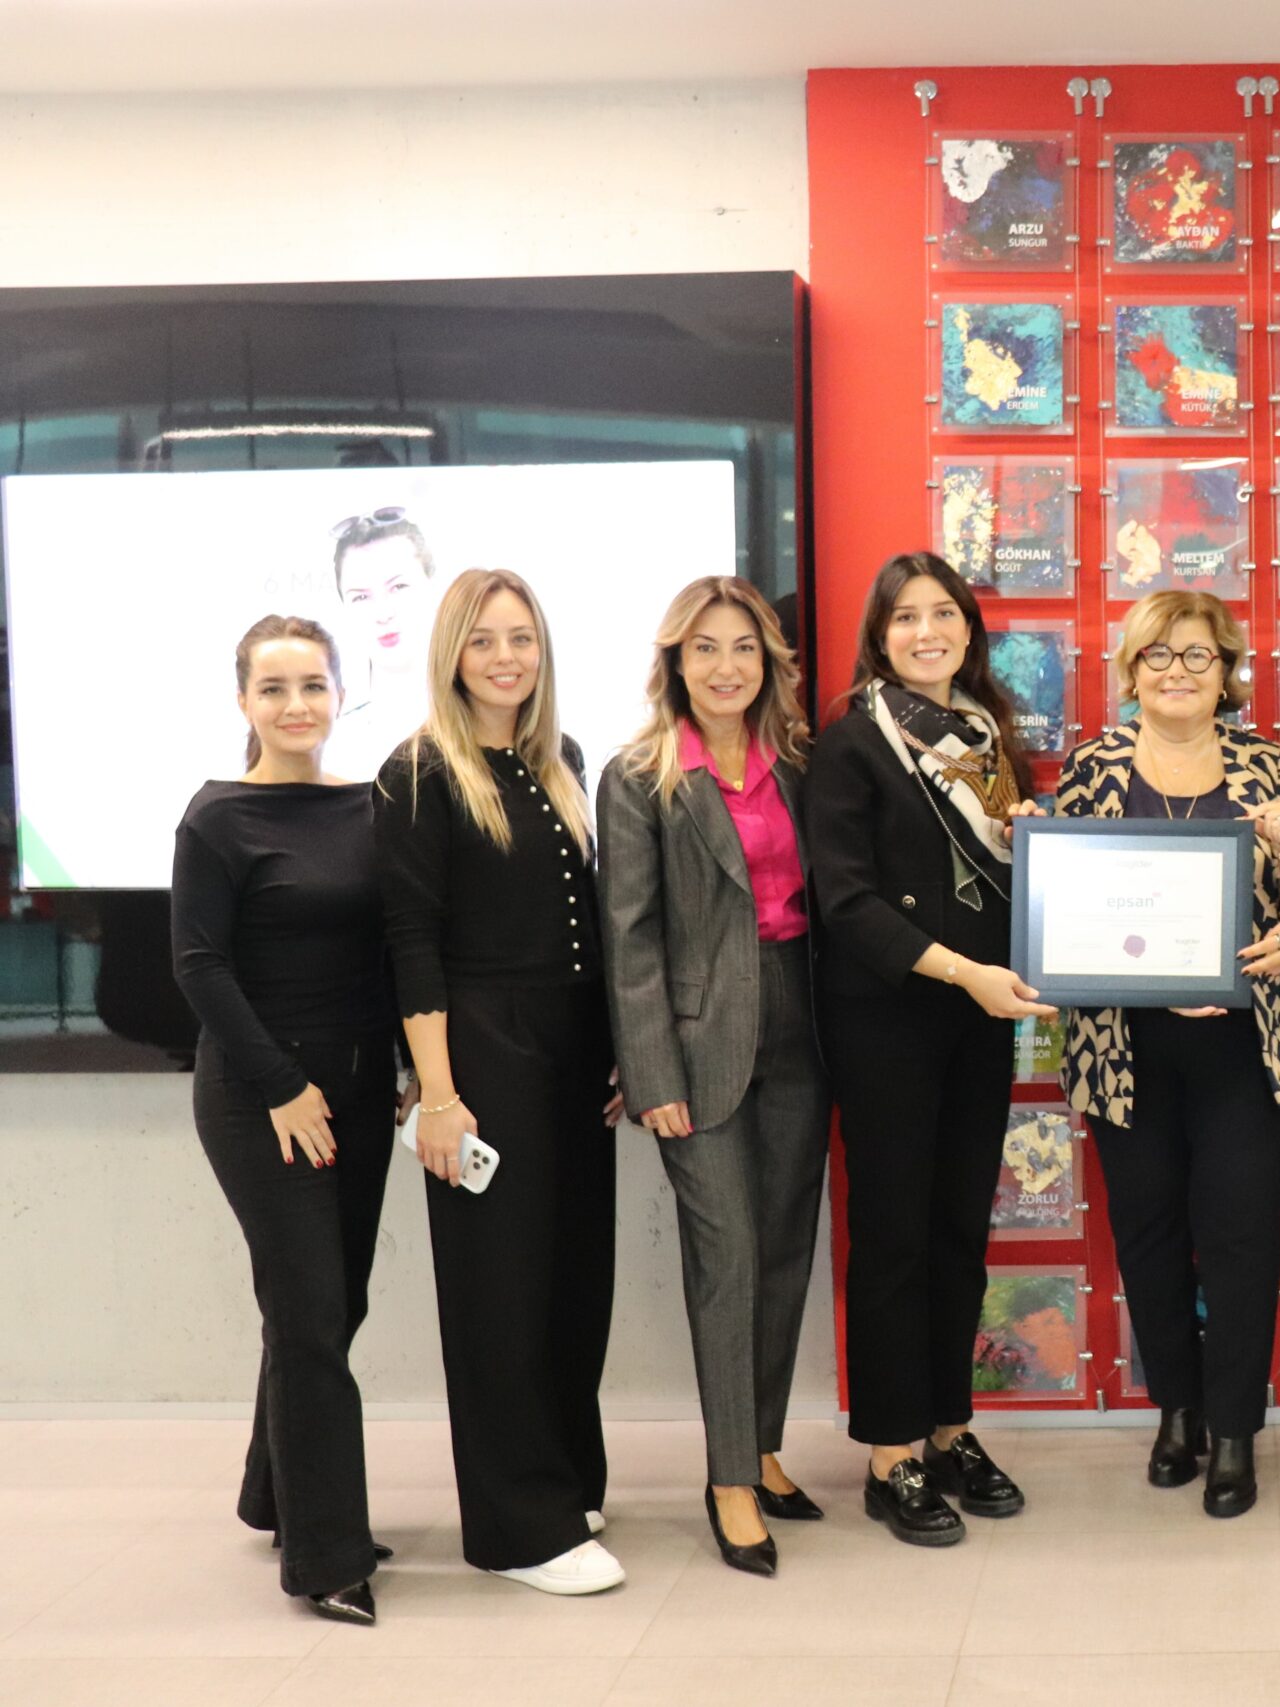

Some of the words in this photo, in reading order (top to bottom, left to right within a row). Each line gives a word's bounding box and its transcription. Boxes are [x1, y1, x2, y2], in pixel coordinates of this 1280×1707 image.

[1008, 223, 1044, 235] ARZU
[1008, 238, 1048, 248] SUNGUR
[995, 546, 1051, 560] GÖKHAN
[1173, 552, 1225, 564] MELTEM
[1106, 895, 1155, 911] epsan
[1017, 1194, 1059, 1205] ZORLU
